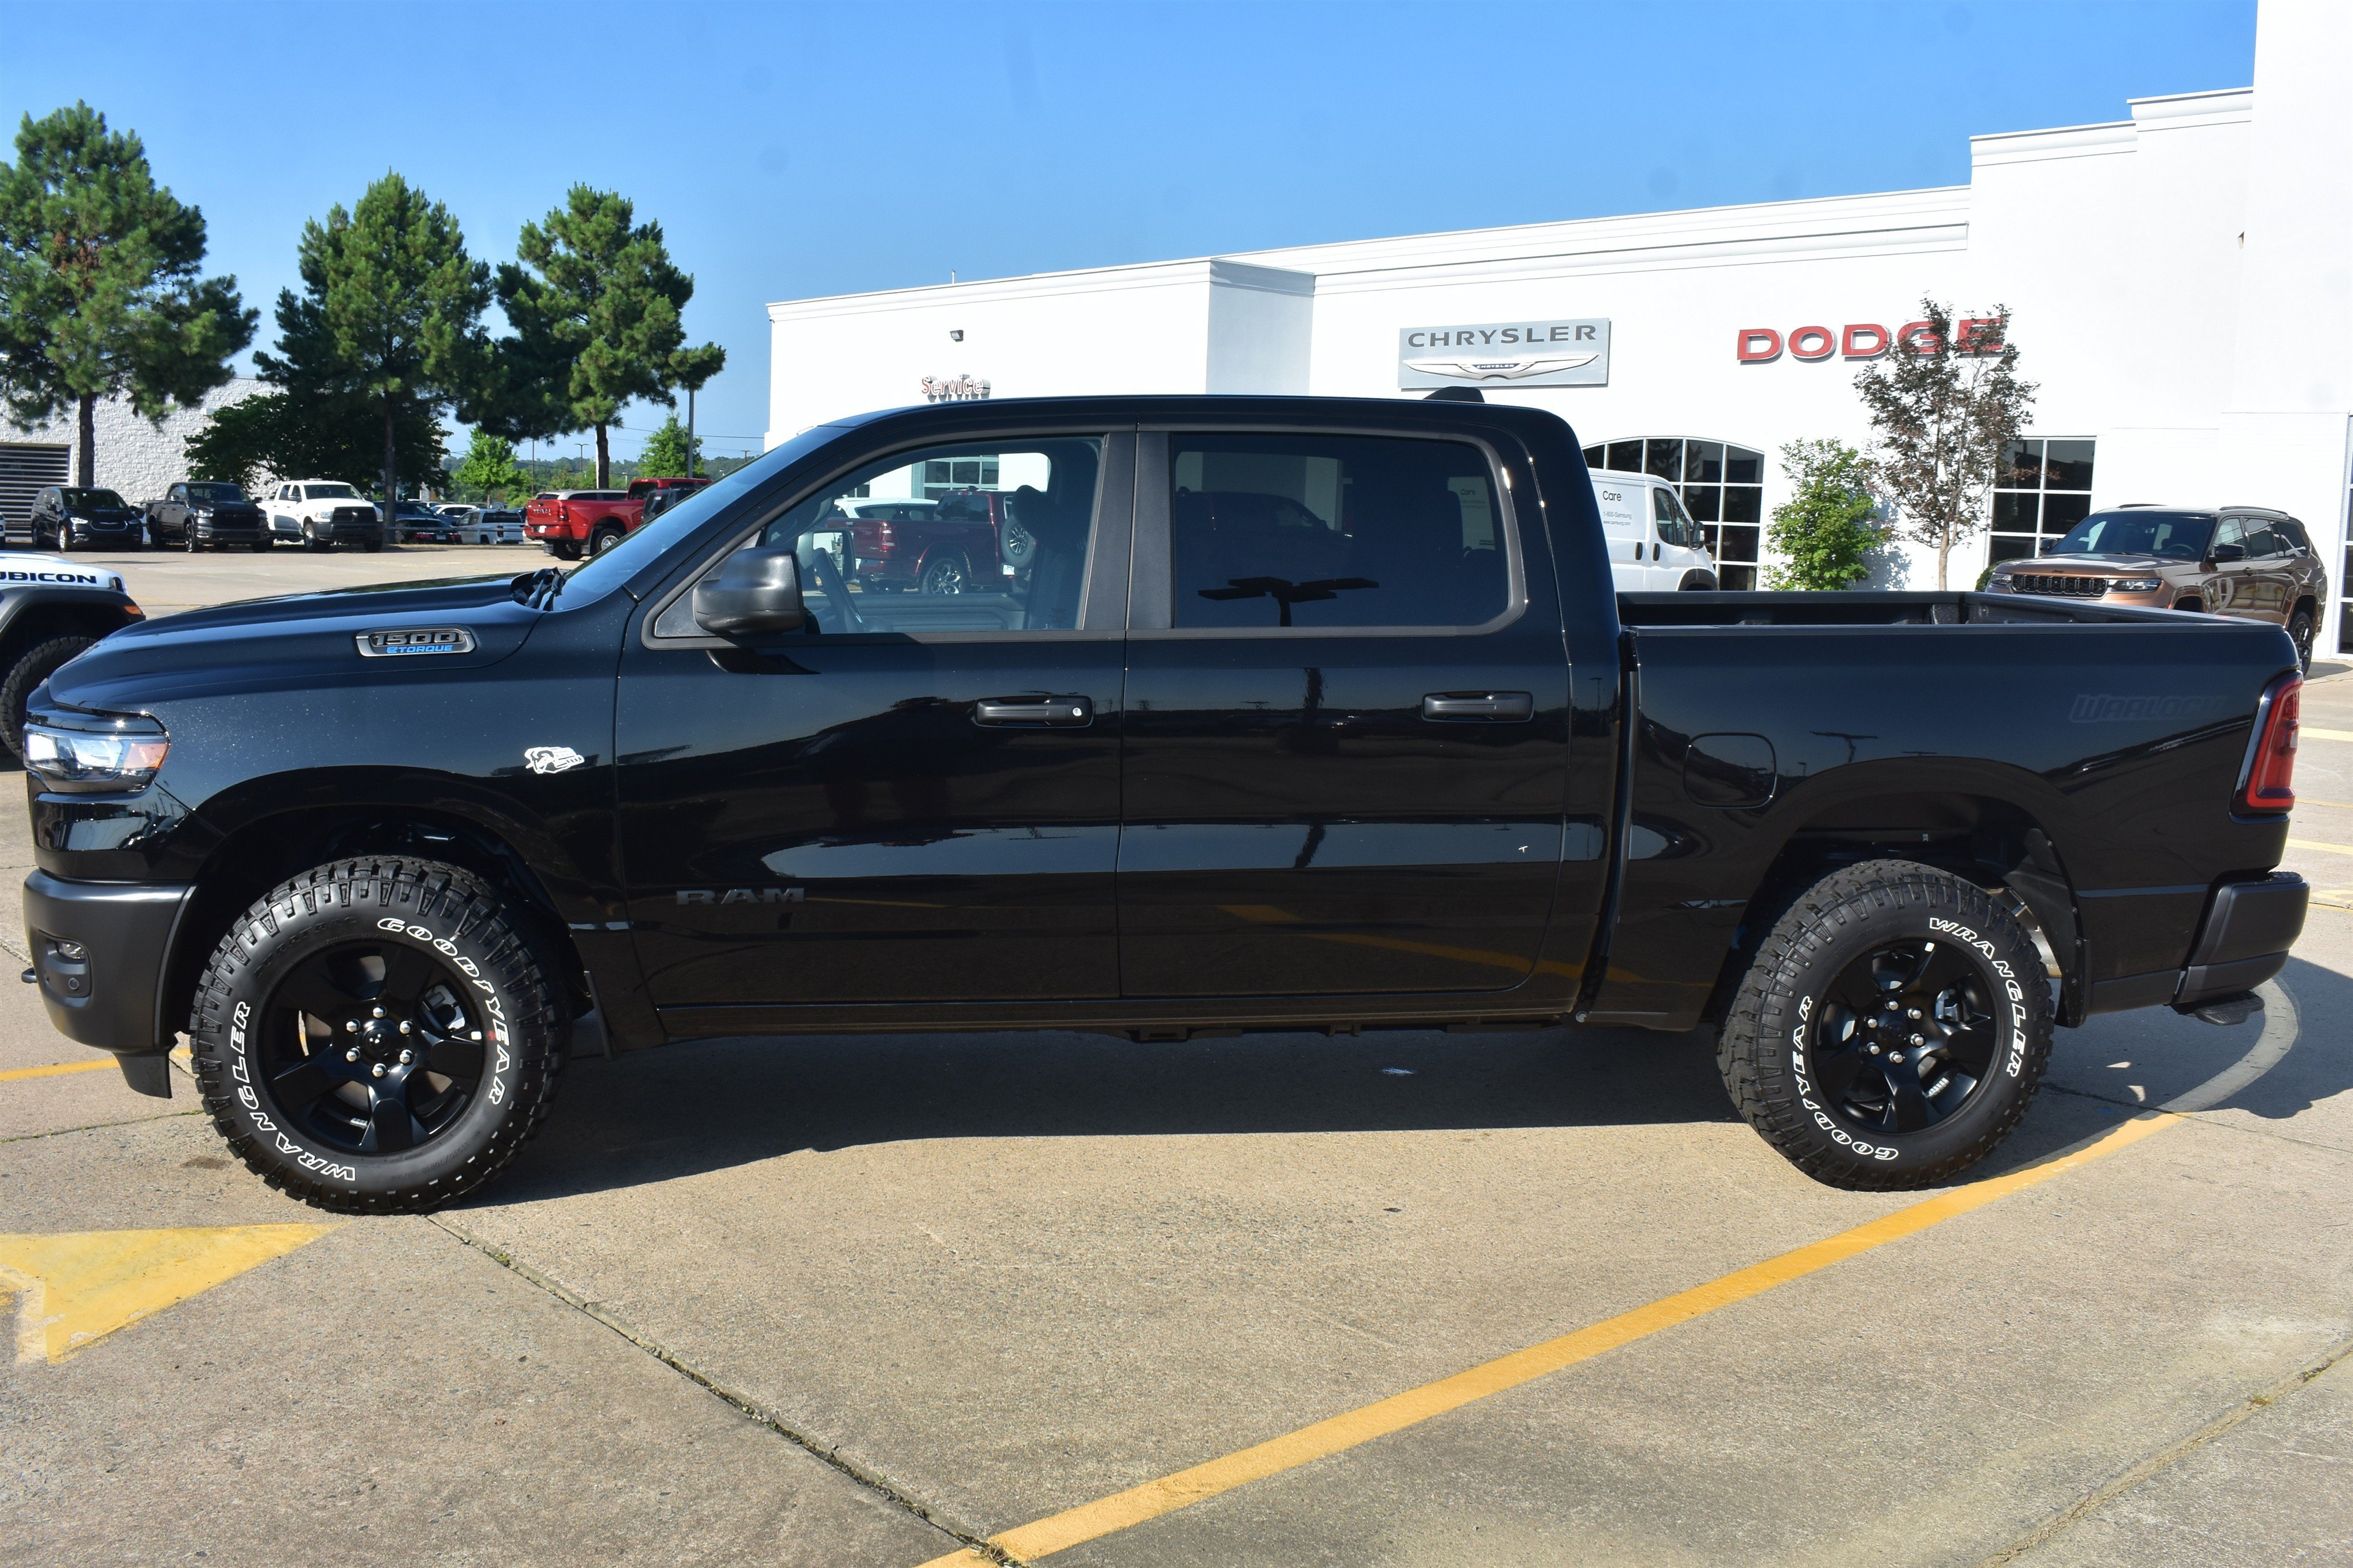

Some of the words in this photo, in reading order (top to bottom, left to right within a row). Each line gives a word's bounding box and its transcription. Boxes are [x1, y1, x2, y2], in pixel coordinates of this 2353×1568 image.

[1407, 325, 1596, 347] CHRYSLER
[1737, 318, 2005, 360] DODGE
[921, 374, 986, 396] Service
[1602, 490, 1622, 501] Care
[1603, 511, 1632, 520] 1-800-Samsung
[374, 632, 457, 646] 1500
[676, 887, 805, 905] RAM
[1929, 917, 2026, 1077] WRANGLER
[377, 918, 510, 1105] GOODYEAR
[1792, 995, 1899, 1160] GOODYEAR
[230, 1001, 356, 1181] WRANGLER
